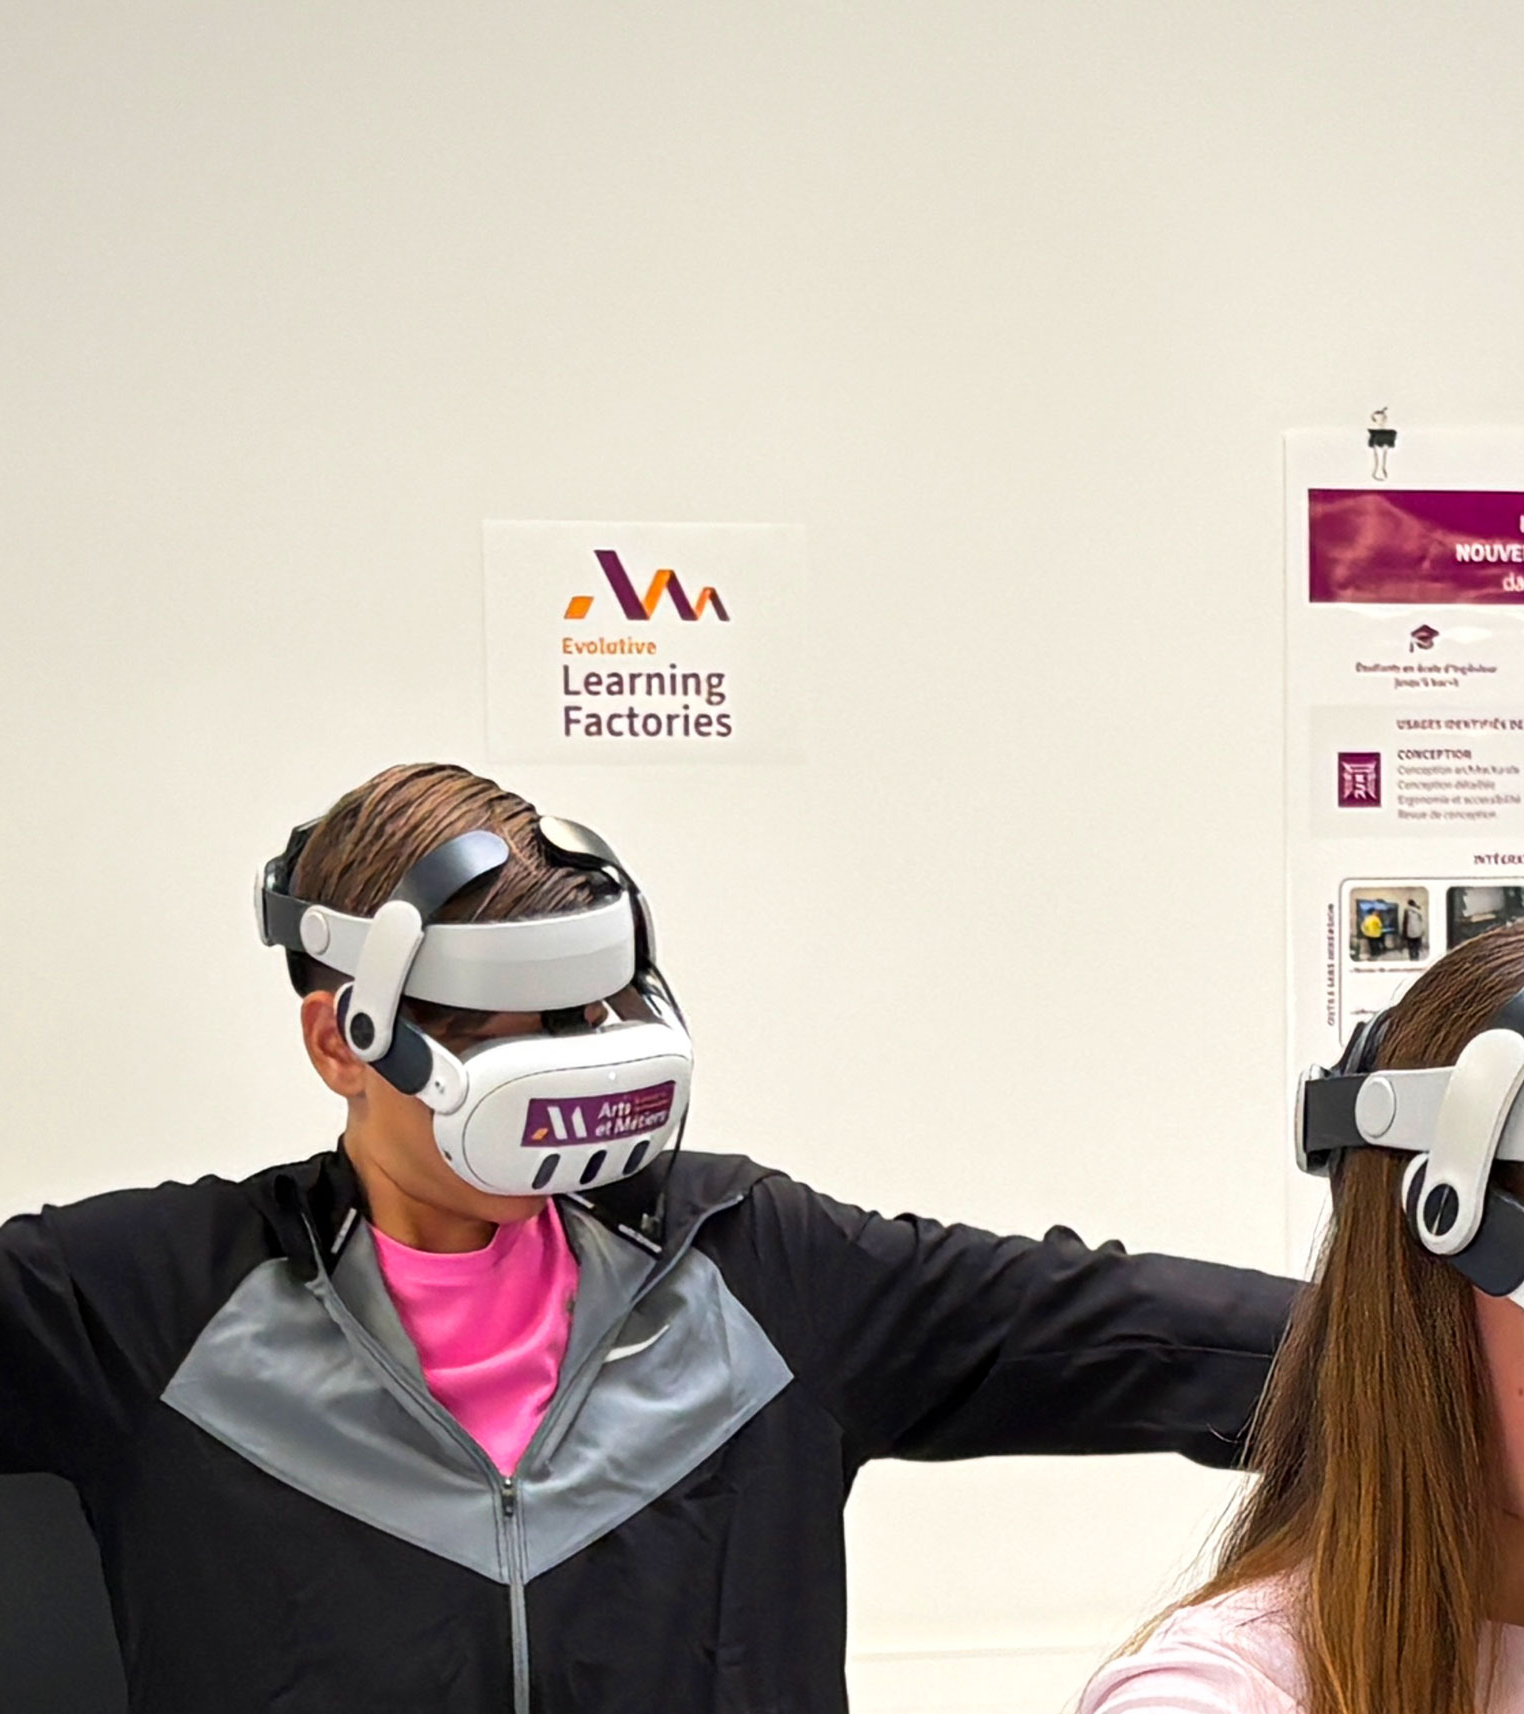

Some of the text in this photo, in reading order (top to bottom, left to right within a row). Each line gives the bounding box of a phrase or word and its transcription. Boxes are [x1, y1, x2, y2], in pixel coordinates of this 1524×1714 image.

[563, 663, 726, 706] Learning
[564, 704, 733, 737] Factories
[597, 1101, 631, 1119] Arts
[595, 1120, 612, 1137] et
